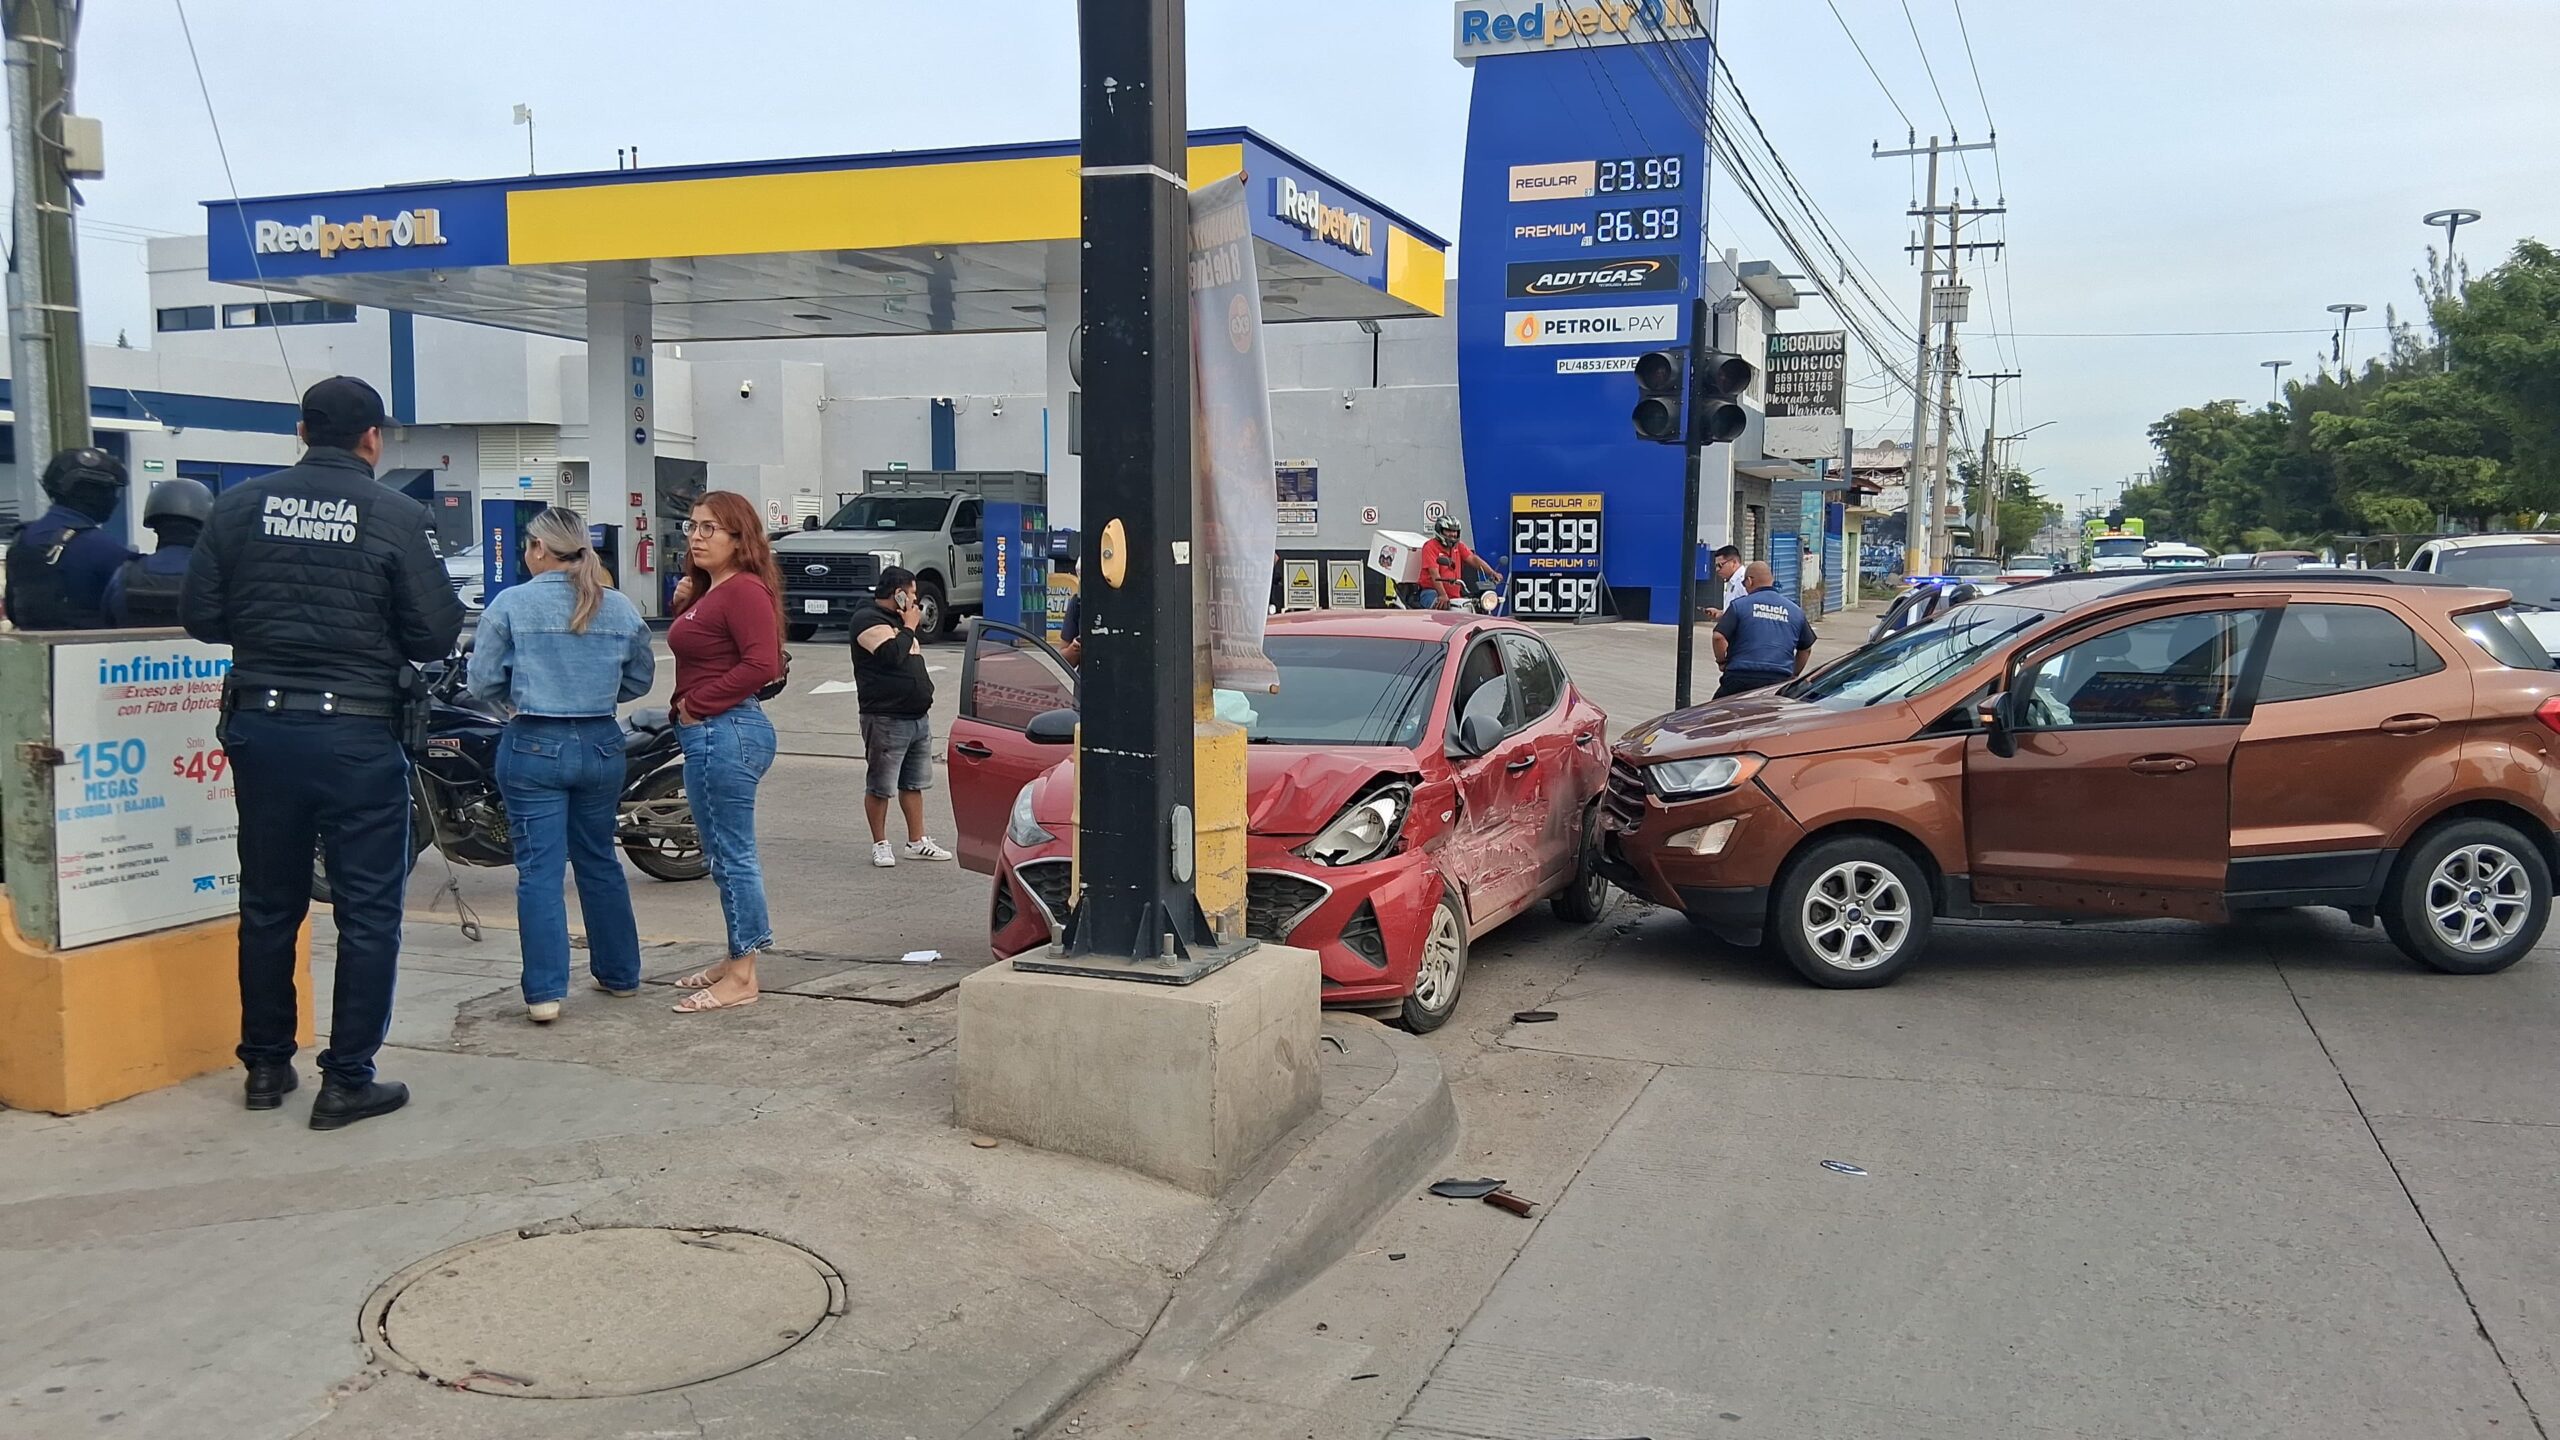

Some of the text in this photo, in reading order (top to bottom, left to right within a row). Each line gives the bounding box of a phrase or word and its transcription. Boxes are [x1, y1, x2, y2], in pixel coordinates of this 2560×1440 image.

[1516, 175, 1577, 189] REGULAR
[1599, 158, 1681, 192] 23.99
[1515, 222, 1586, 239] PREMIUM
[1597, 208, 1679, 242] 26.99
[1536, 268, 1647, 287] ADITIGAS
[1544, 315, 1665, 335] PETROIL PAY
[1770, 334, 1842, 353] ABOGADOS
[1558, 358, 1637, 371] PL/4853/EXP/E
[1767, 354, 1843, 372] DIVORCIOS
[1765, 390, 1826, 405] Mercado de
[1787, 404, 1836, 416] Mariscos
[264, 496, 358, 524] POLICÍA
[771, 506, 778, 515] 10
[1429, 506, 1441, 516] 10
[1531, 499, 1582, 508] REGULAR
[263, 515, 357, 543] TRÁNSITO
[1516, 519, 1597, 553] 23.99
[1529, 558, 1583, 568] PREMIUM
[1515, 578, 1597, 613] 26.99
[1753, 604, 1789, 616] POLICÍA
[1753, 611, 1789, 622] MUNICIPAL
[126, 680, 224, 698] Exceso de Veloci
[118, 696, 222, 716] con Fibra Óptica
[186, 737, 205, 748] Solo
[75, 738, 147, 780] 150
[85, 778, 138, 801] MEGAS
[207, 785, 236, 800] al me
[58, 809, 71, 821] DE
[75, 803, 112, 819] SUBIDA
[124, 796, 166, 813] BAJADA
[219, 874, 241, 885] TEL
